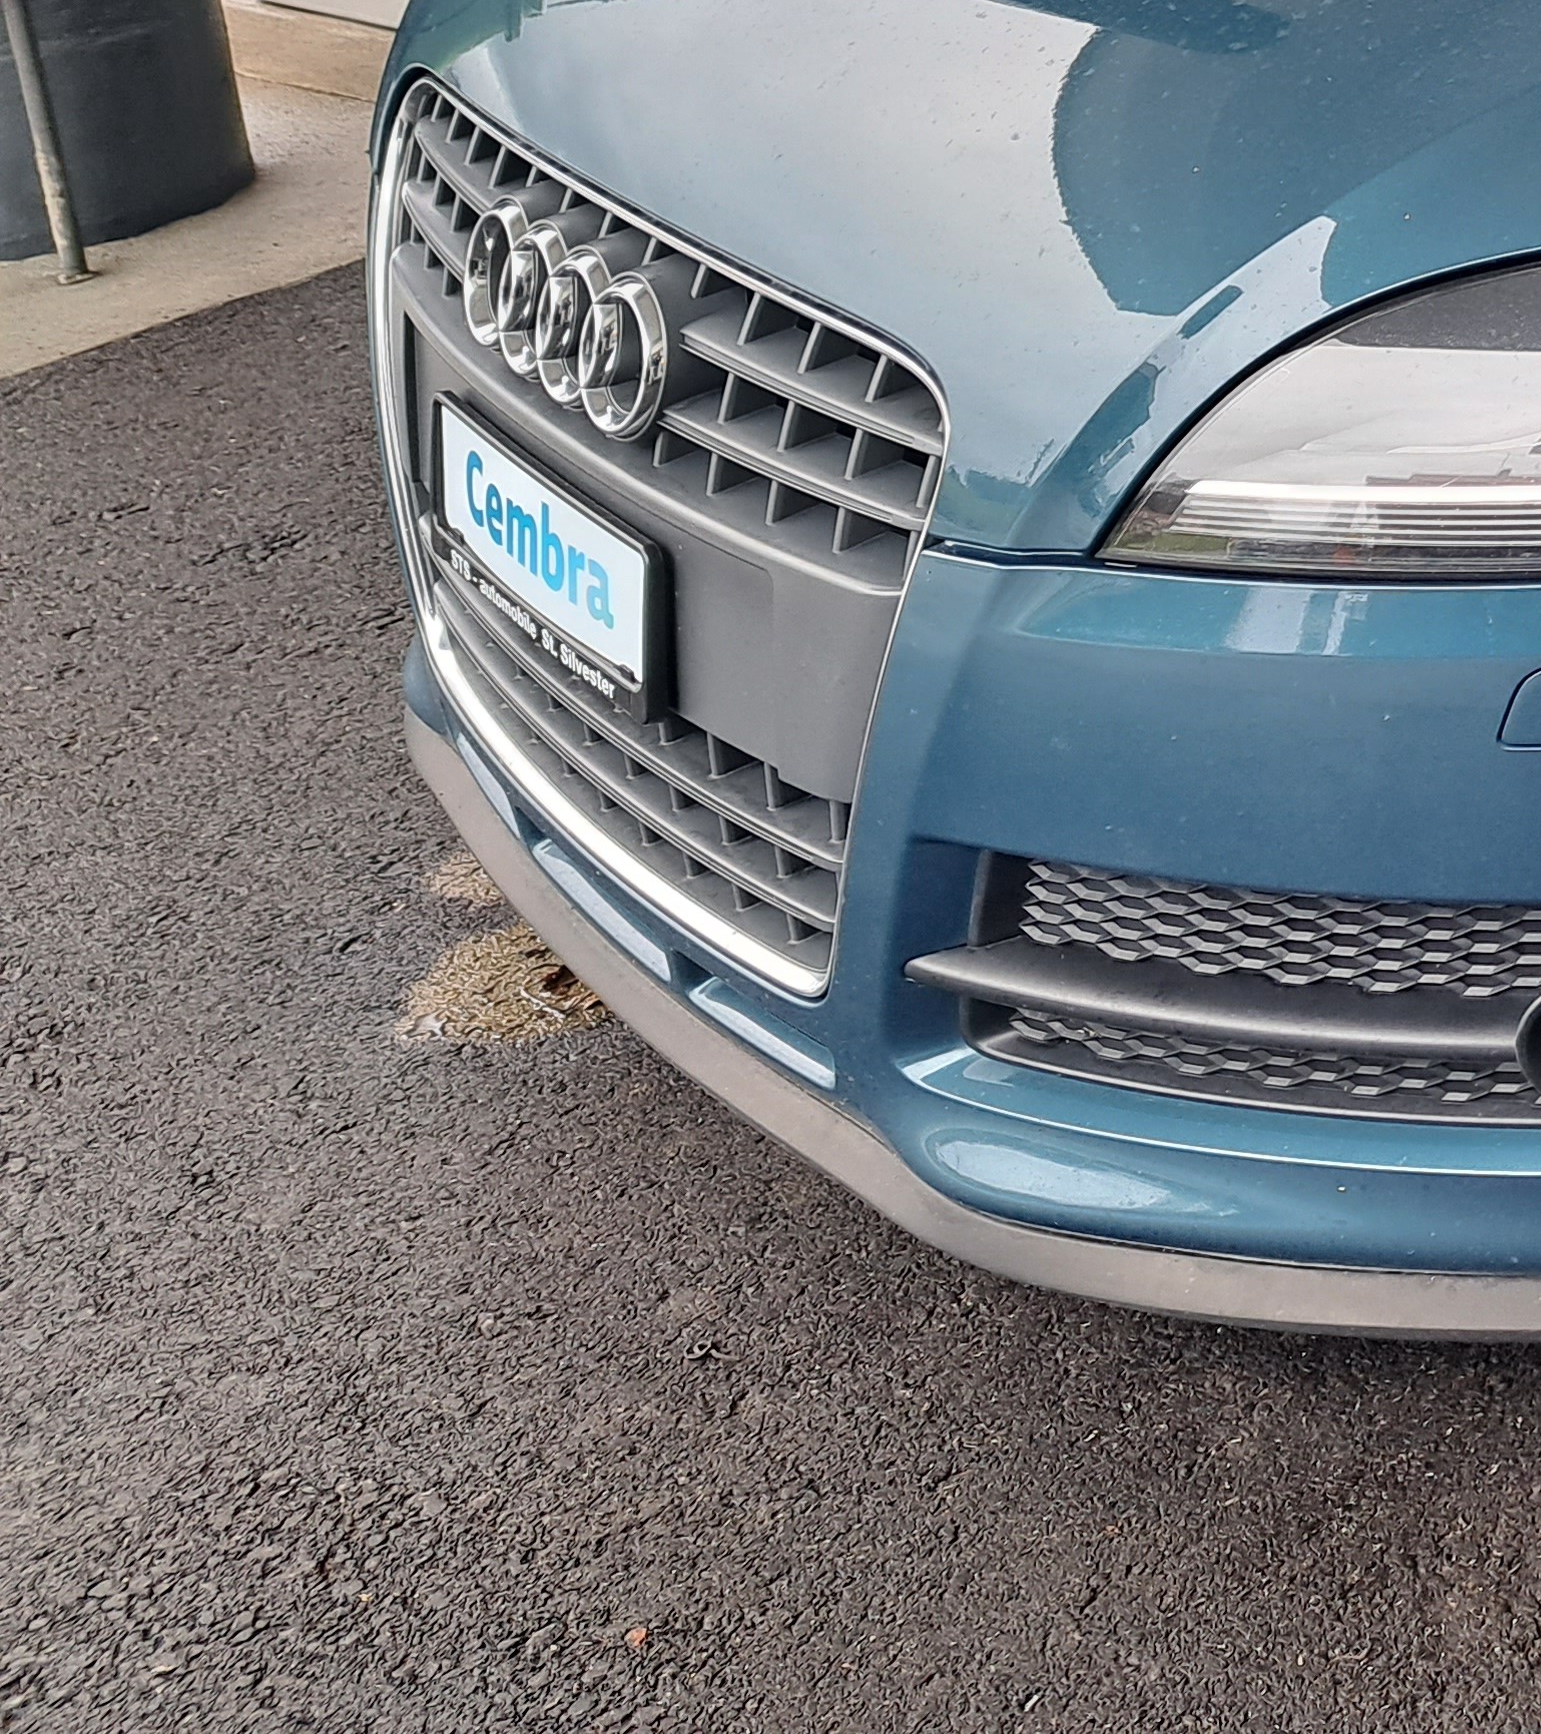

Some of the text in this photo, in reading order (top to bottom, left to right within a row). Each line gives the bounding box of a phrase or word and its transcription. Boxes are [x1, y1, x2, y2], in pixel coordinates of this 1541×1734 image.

[466, 450, 614, 630] Cembra
[450, 549, 471, 581] STS
[479, 579, 537, 640] automobile
[560, 643, 615, 699] Silvester
